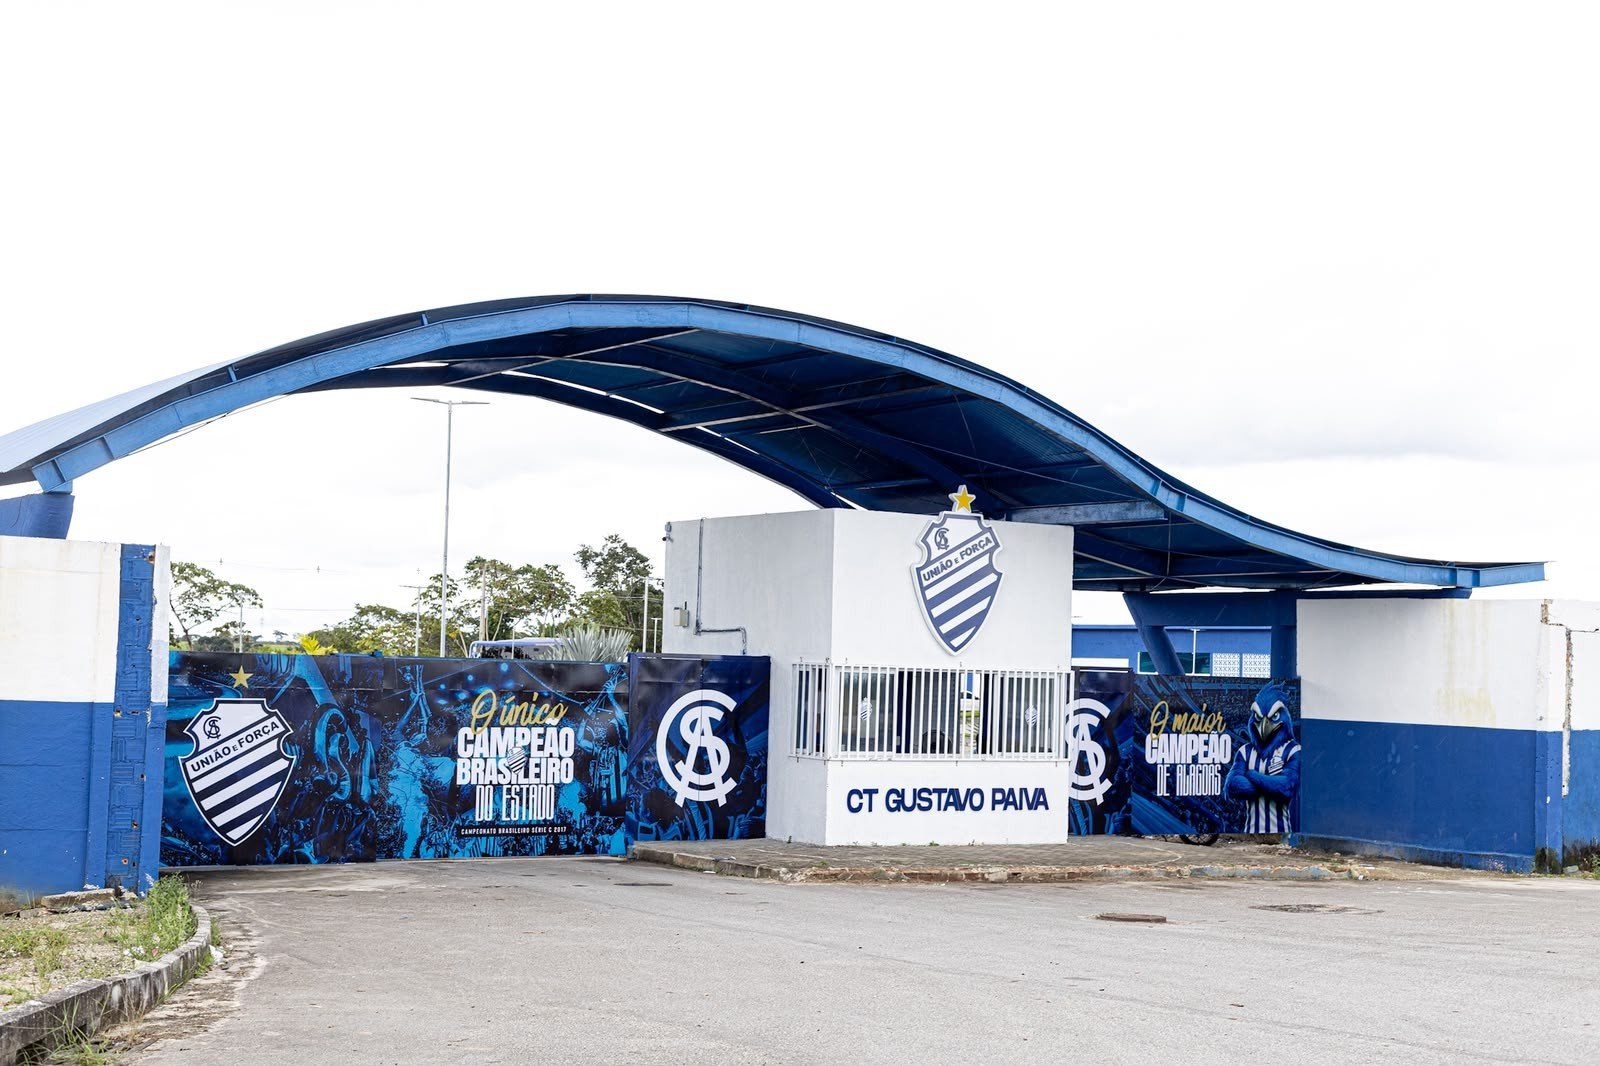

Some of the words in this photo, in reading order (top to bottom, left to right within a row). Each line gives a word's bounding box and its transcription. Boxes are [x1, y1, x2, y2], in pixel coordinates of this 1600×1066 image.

[923, 560, 953, 581] UNIÃO
[960, 536, 992, 560] FORÇA
[471, 689, 496, 735] O
[500, 692, 568, 726] único
[1150, 700, 1170, 741] O
[1172, 703, 1227, 736] maior
[191, 746, 231, 772] UNIÃO
[232, 744, 238, 752] E
[237, 721, 279, 748] FORÇA
[1145, 731, 1232, 764] CAMPEÃO
[1156, 764, 1170, 797] DE
[1176, 764, 1221, 796] ALAGOAS
[475, 785, 493, 821] DO
[502, 784, 555, 820] ESTADO
[846, 788, 879, 814] CT
[885, 787, 985, 813] GUSTAVO
[991, 787, 1050, 811] PAIVA
[531, 825, 547, 833] SÉRIE
